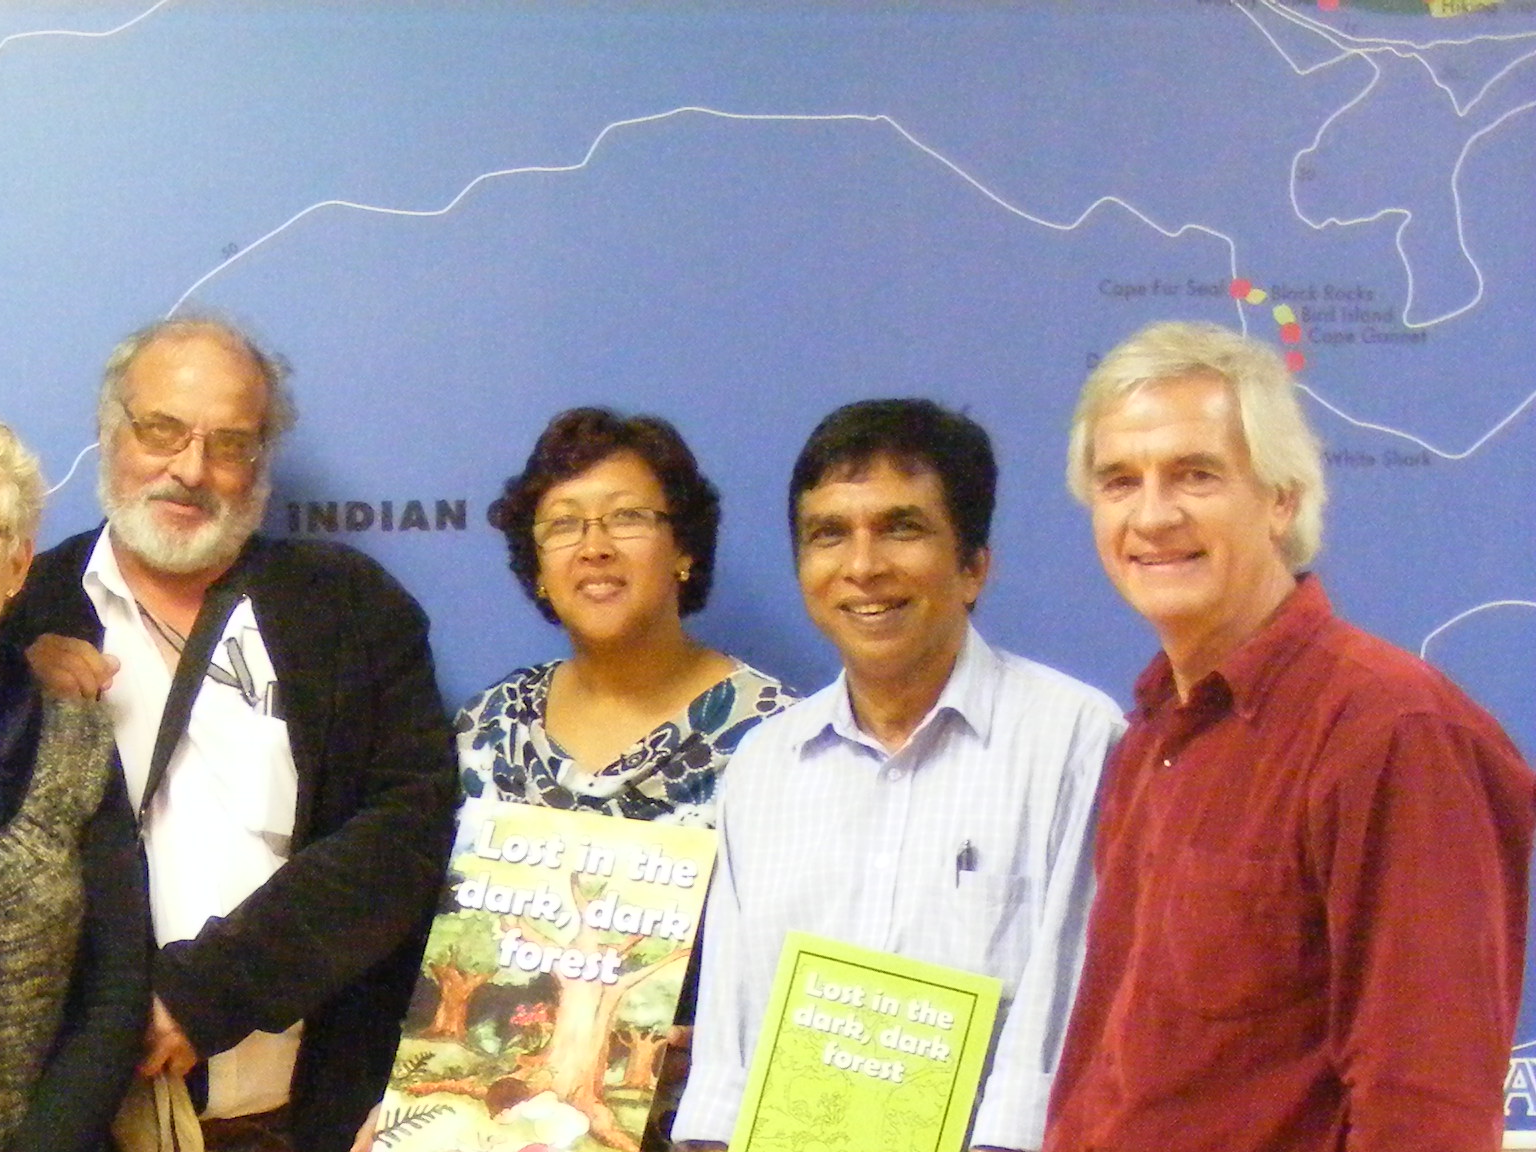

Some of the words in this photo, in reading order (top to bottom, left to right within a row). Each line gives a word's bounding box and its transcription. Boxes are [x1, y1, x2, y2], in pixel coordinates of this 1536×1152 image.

[1308, 327, 1355, 347] Cape
[287, 498, 467, 533] INDIAN
[476, 820, 565, 869] Lost
[574, 836, 615, 877] in
[629, 845, 698, 888] the
[455, 871, 573, 930] dark,
[585, 890, 692, 941] dark
[498, 928, 622, 985] forest
[806, 972, 866, 1008] Lost
[871, 989, 901, 1017] in
[908, 1000, 955, 1031] the
[793, 1004, 872, 1045] dark,
[880, 1025, 951, 1063] dark
[823, 1041, 905, 1084] forest
